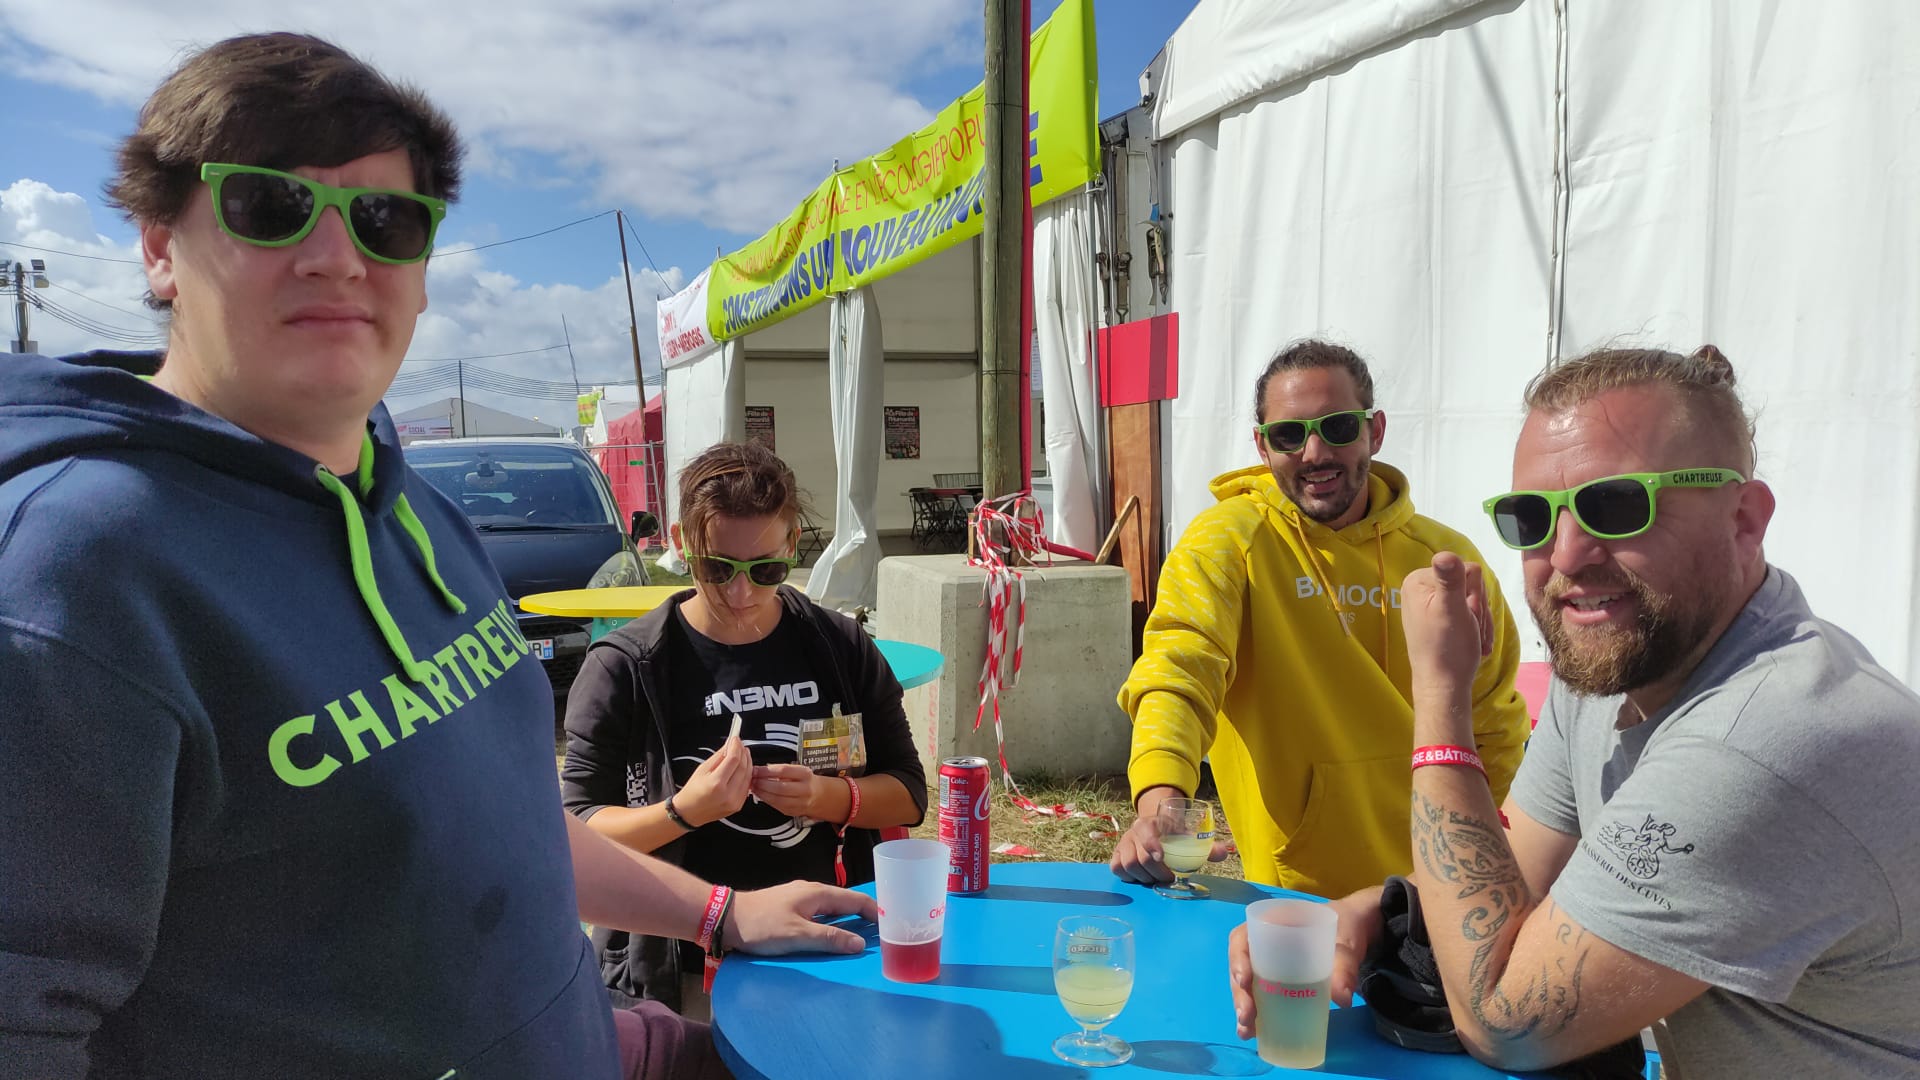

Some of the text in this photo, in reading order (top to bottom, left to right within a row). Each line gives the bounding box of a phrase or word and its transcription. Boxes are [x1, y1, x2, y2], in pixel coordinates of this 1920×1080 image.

[1672, 472, 1723, 484] CHARTREUSE
[1426, 750, 1434, 761] &
[1616, 871, 1636, 890] DES
[1637, 885, 1672, 911] CUVES
